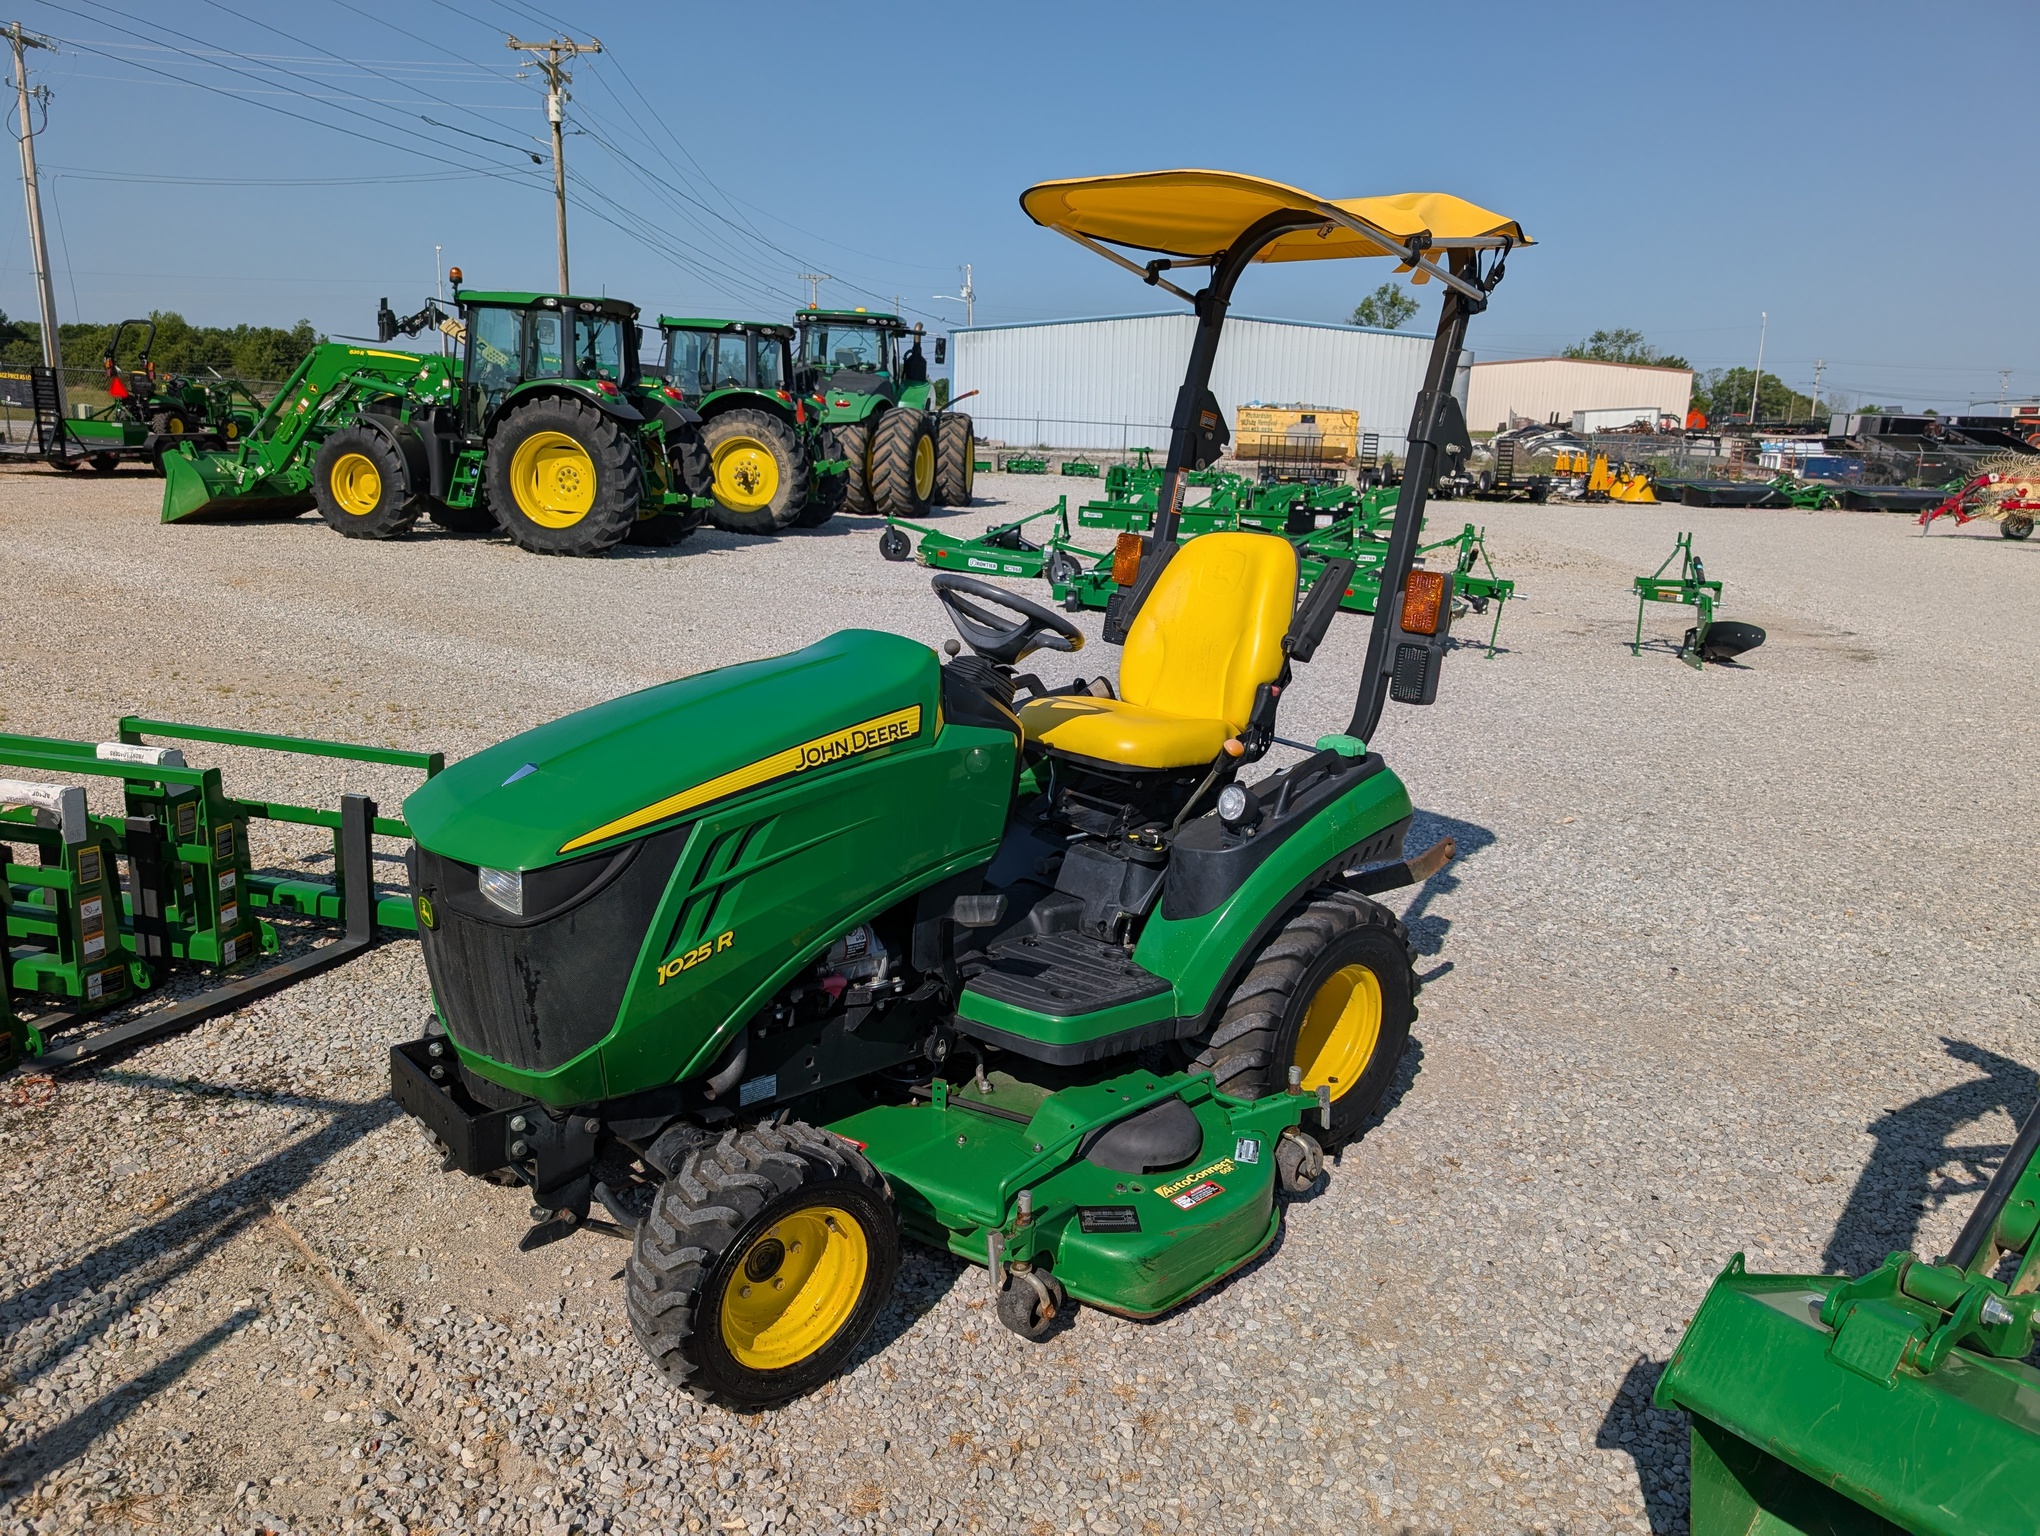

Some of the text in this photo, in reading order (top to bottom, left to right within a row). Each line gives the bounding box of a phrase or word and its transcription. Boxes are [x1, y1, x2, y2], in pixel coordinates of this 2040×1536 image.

[796, 720, 910, 769] JOHN DEERE
[1162, 1158, 1235, 1197] AutoConnect
